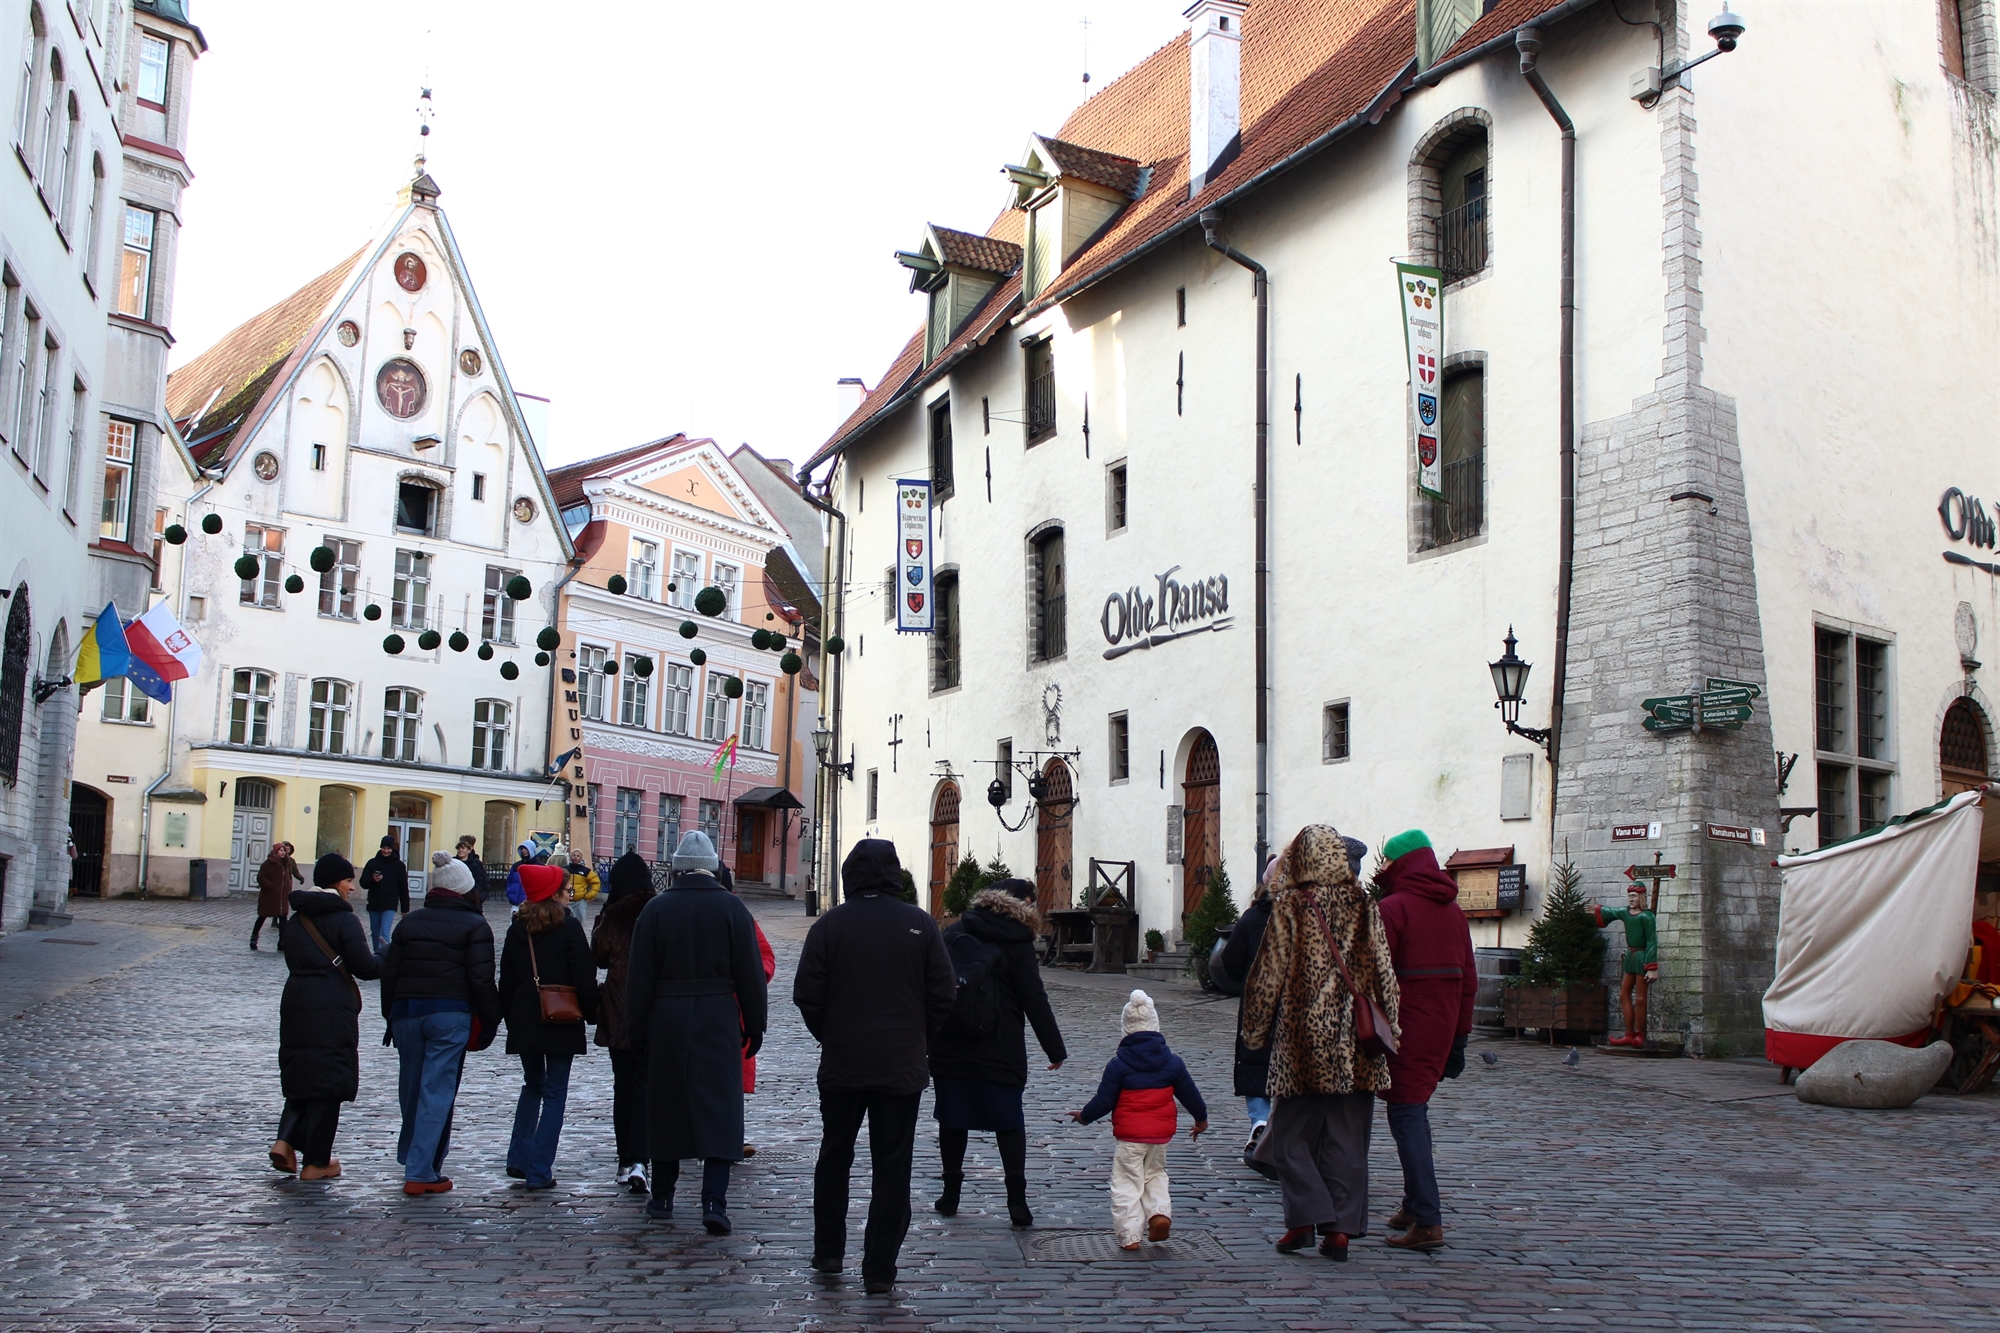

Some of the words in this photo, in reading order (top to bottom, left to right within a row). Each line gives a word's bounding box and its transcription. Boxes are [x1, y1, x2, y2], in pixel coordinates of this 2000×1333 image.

[1938, 486, 1996, 550] Olde
[1100, 585, 1154, 645] Olde
[565, 690, 587, 817] MUUSEUM
[1615, 828, 1631, 836] Vana
[1632, 827, 1646, 836] turg
[1711, 827, 1735, 838] Vanaturu
[1735, 830, 1748, 839] kael
[1754, 832, 1762, 841] 12
